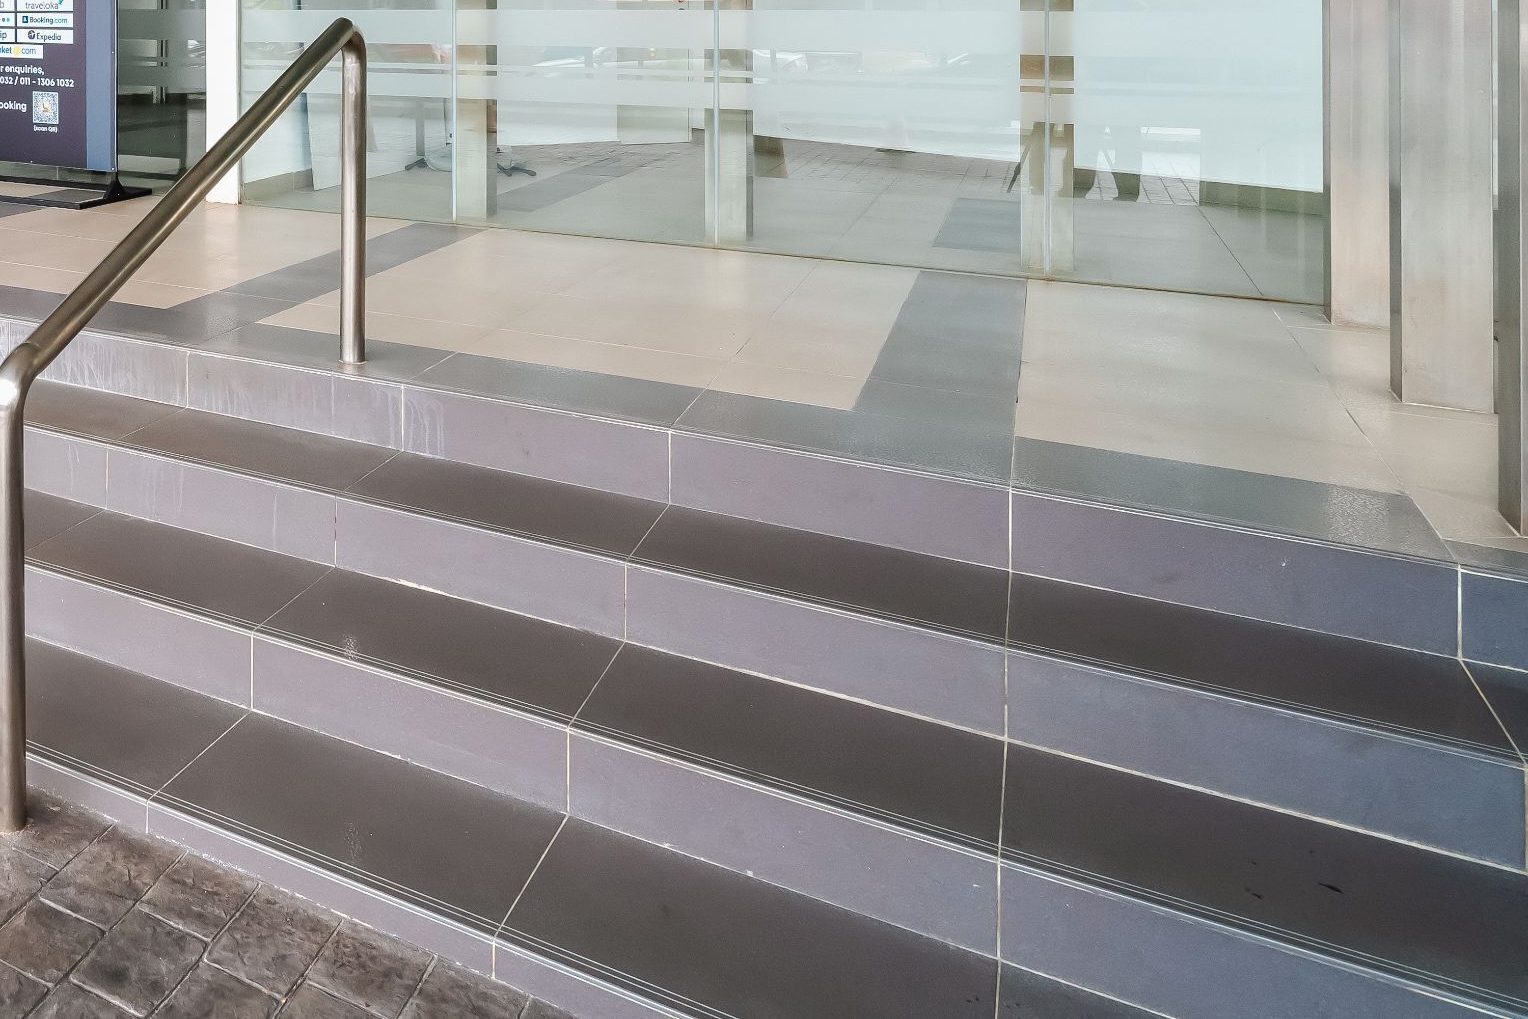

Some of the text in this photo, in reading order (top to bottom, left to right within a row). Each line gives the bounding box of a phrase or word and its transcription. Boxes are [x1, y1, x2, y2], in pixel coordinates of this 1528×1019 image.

[25, 1, 59, 10] traveloka
[29, 16, 68, 25] Booking.com
[36, 33, 62, 42] Expedia
[5, 65, 45, 75] enquiries,
